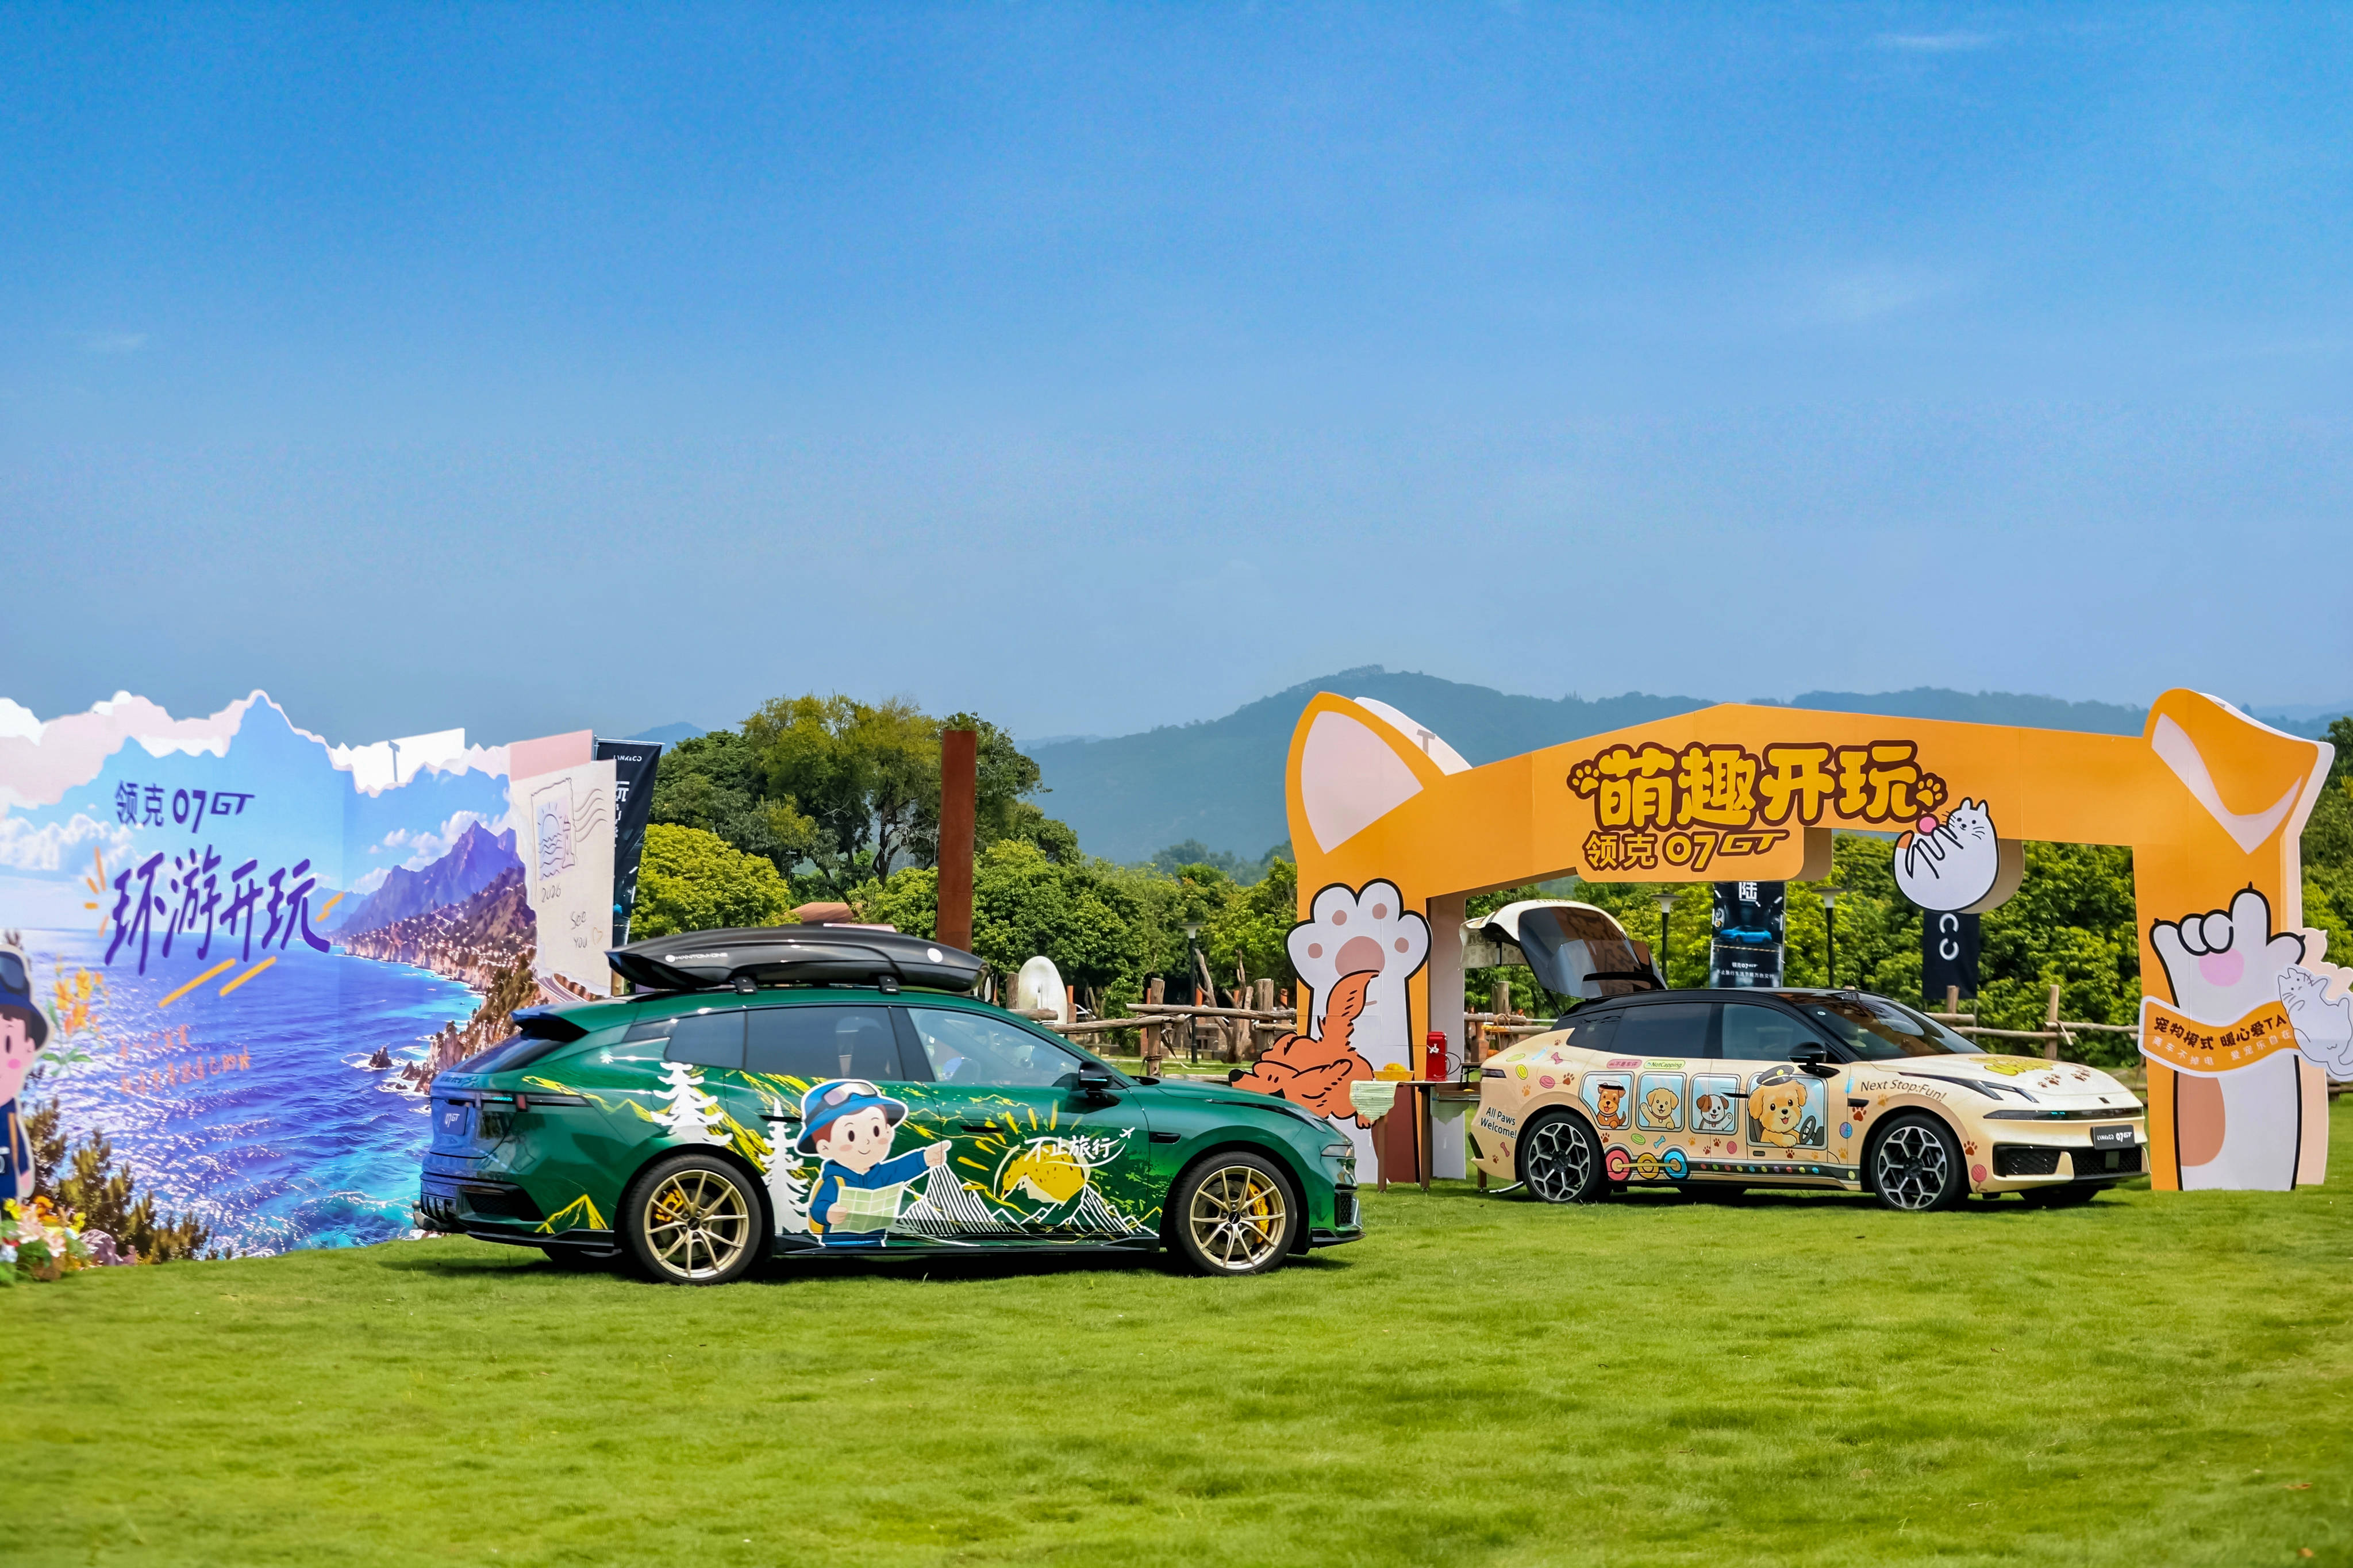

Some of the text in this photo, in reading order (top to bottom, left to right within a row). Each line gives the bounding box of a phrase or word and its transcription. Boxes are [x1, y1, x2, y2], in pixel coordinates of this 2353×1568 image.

[1596, 742, 1920, 829] 萌趣开玩
[541, 883, 562, 903] 2026
[104, 844, 330, 976] 环游开玩
[2154, 1014, 2287, 1051] 宠物模式 暖心爱TA
[1860, 1081, 1888, 1092] Next
[1481, 1117, 1517, 1139] Welcome!
[1486, 1106, 1516, 1125] All Paws
[1024, 1134, 1120, 1163] 不止旅行
